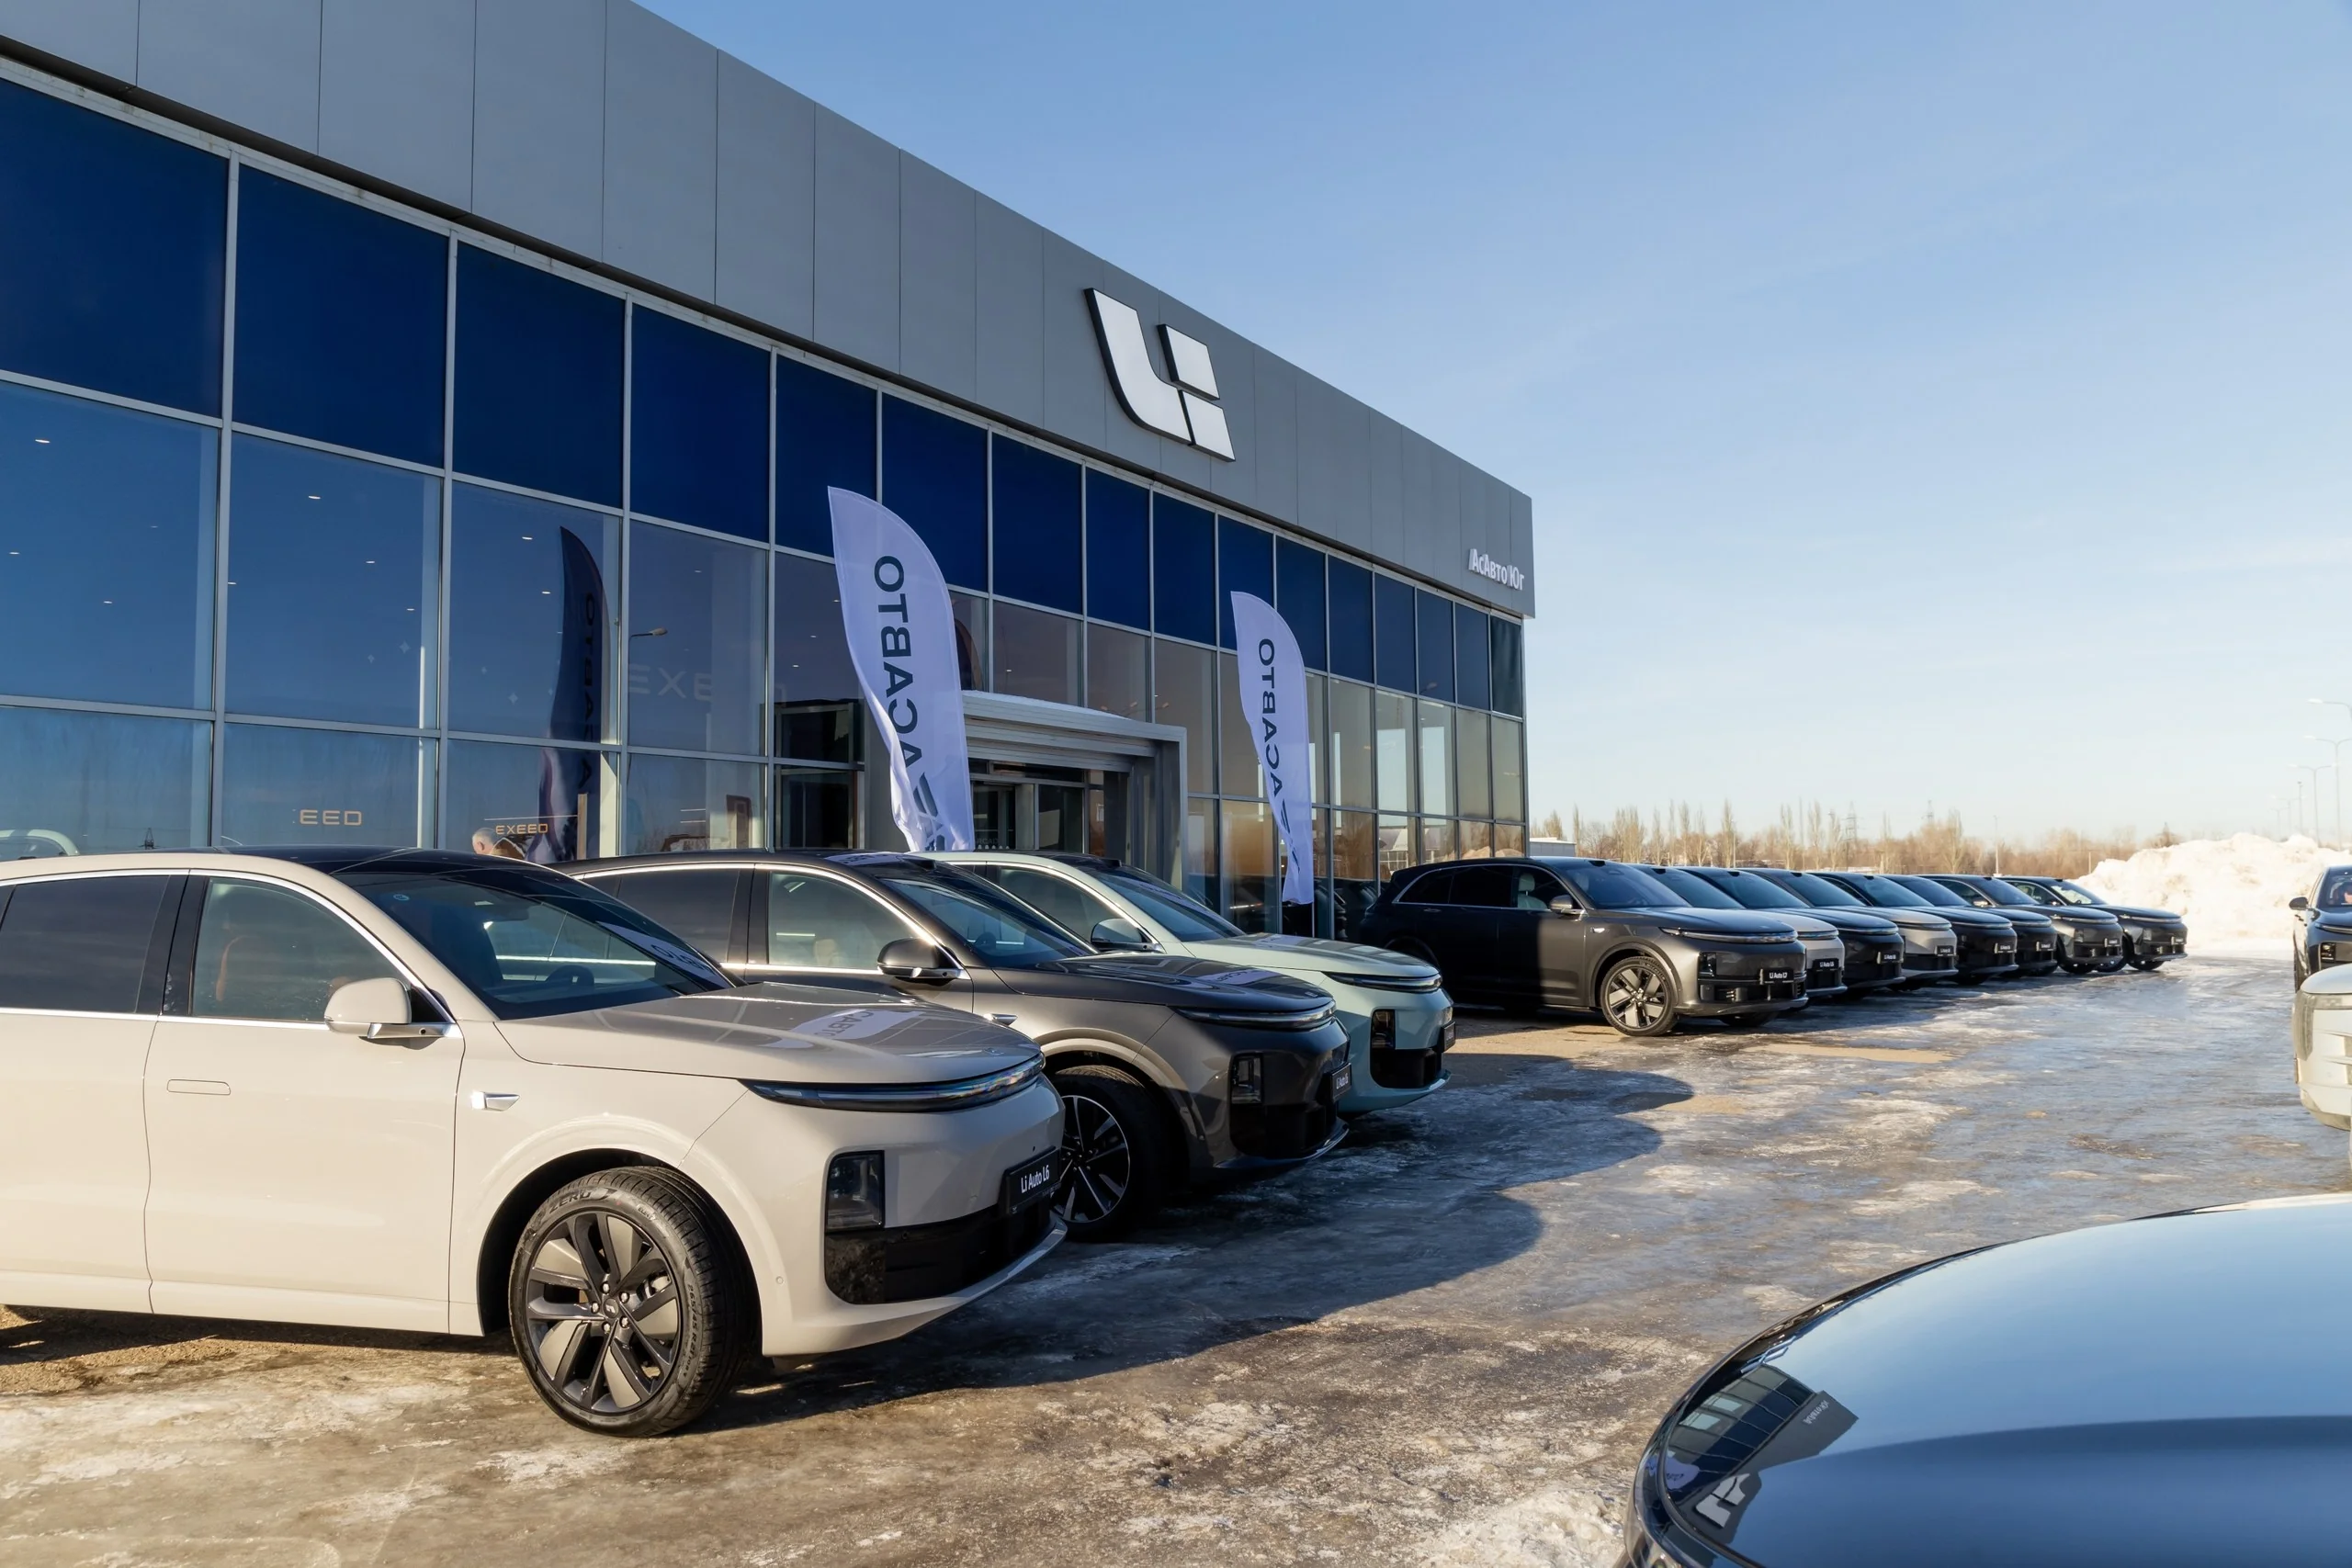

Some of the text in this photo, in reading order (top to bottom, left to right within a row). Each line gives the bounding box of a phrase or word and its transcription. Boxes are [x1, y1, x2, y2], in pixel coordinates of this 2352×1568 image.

[1507, 565, 1525, 591] Юг
[293, 809, 362, 826] EED
[496, 823, 548, 835] EXEED
[1021, 1176, 1028, 1193] Li
[1028, 1171, 1043, 1190] Auto
[1042, 1164, 1050, 1182] L6
